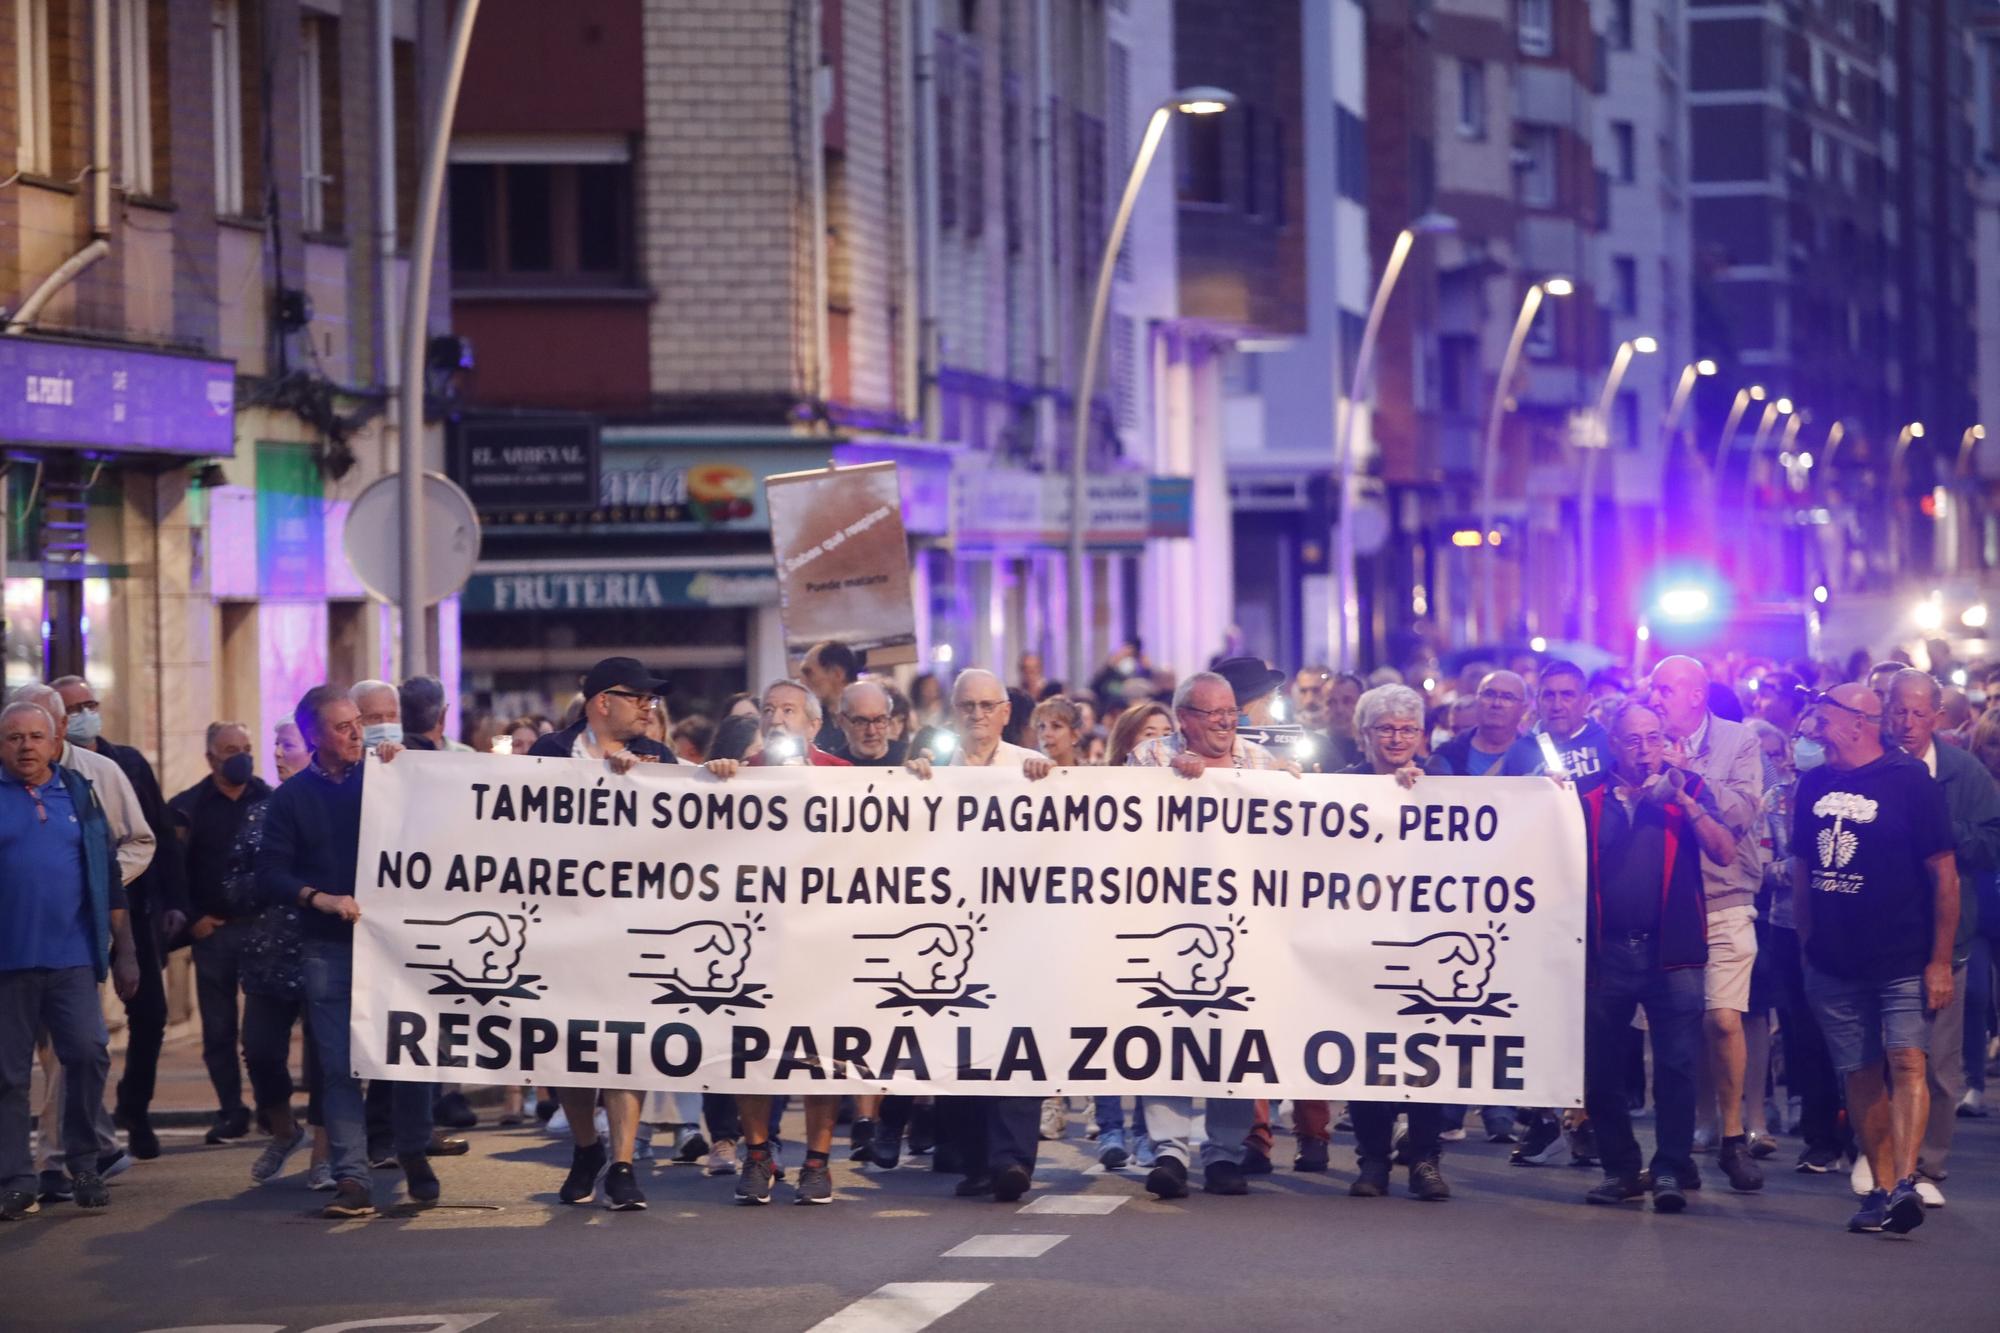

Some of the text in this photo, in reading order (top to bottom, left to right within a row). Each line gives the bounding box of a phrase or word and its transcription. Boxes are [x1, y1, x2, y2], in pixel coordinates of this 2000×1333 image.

[472, 777, 1498, 844] TAMBIÉN SOMOS GIJÓN Y PAGAMOS IMPUESTOS, PERO
[377, 850, 1536, 914] NO APARECEMOS EN PLANES, INVERSIONES NI PROYECTOS
[385, 1010, 1525, 1091] RESPETO PARA LA ZONA OESTE
